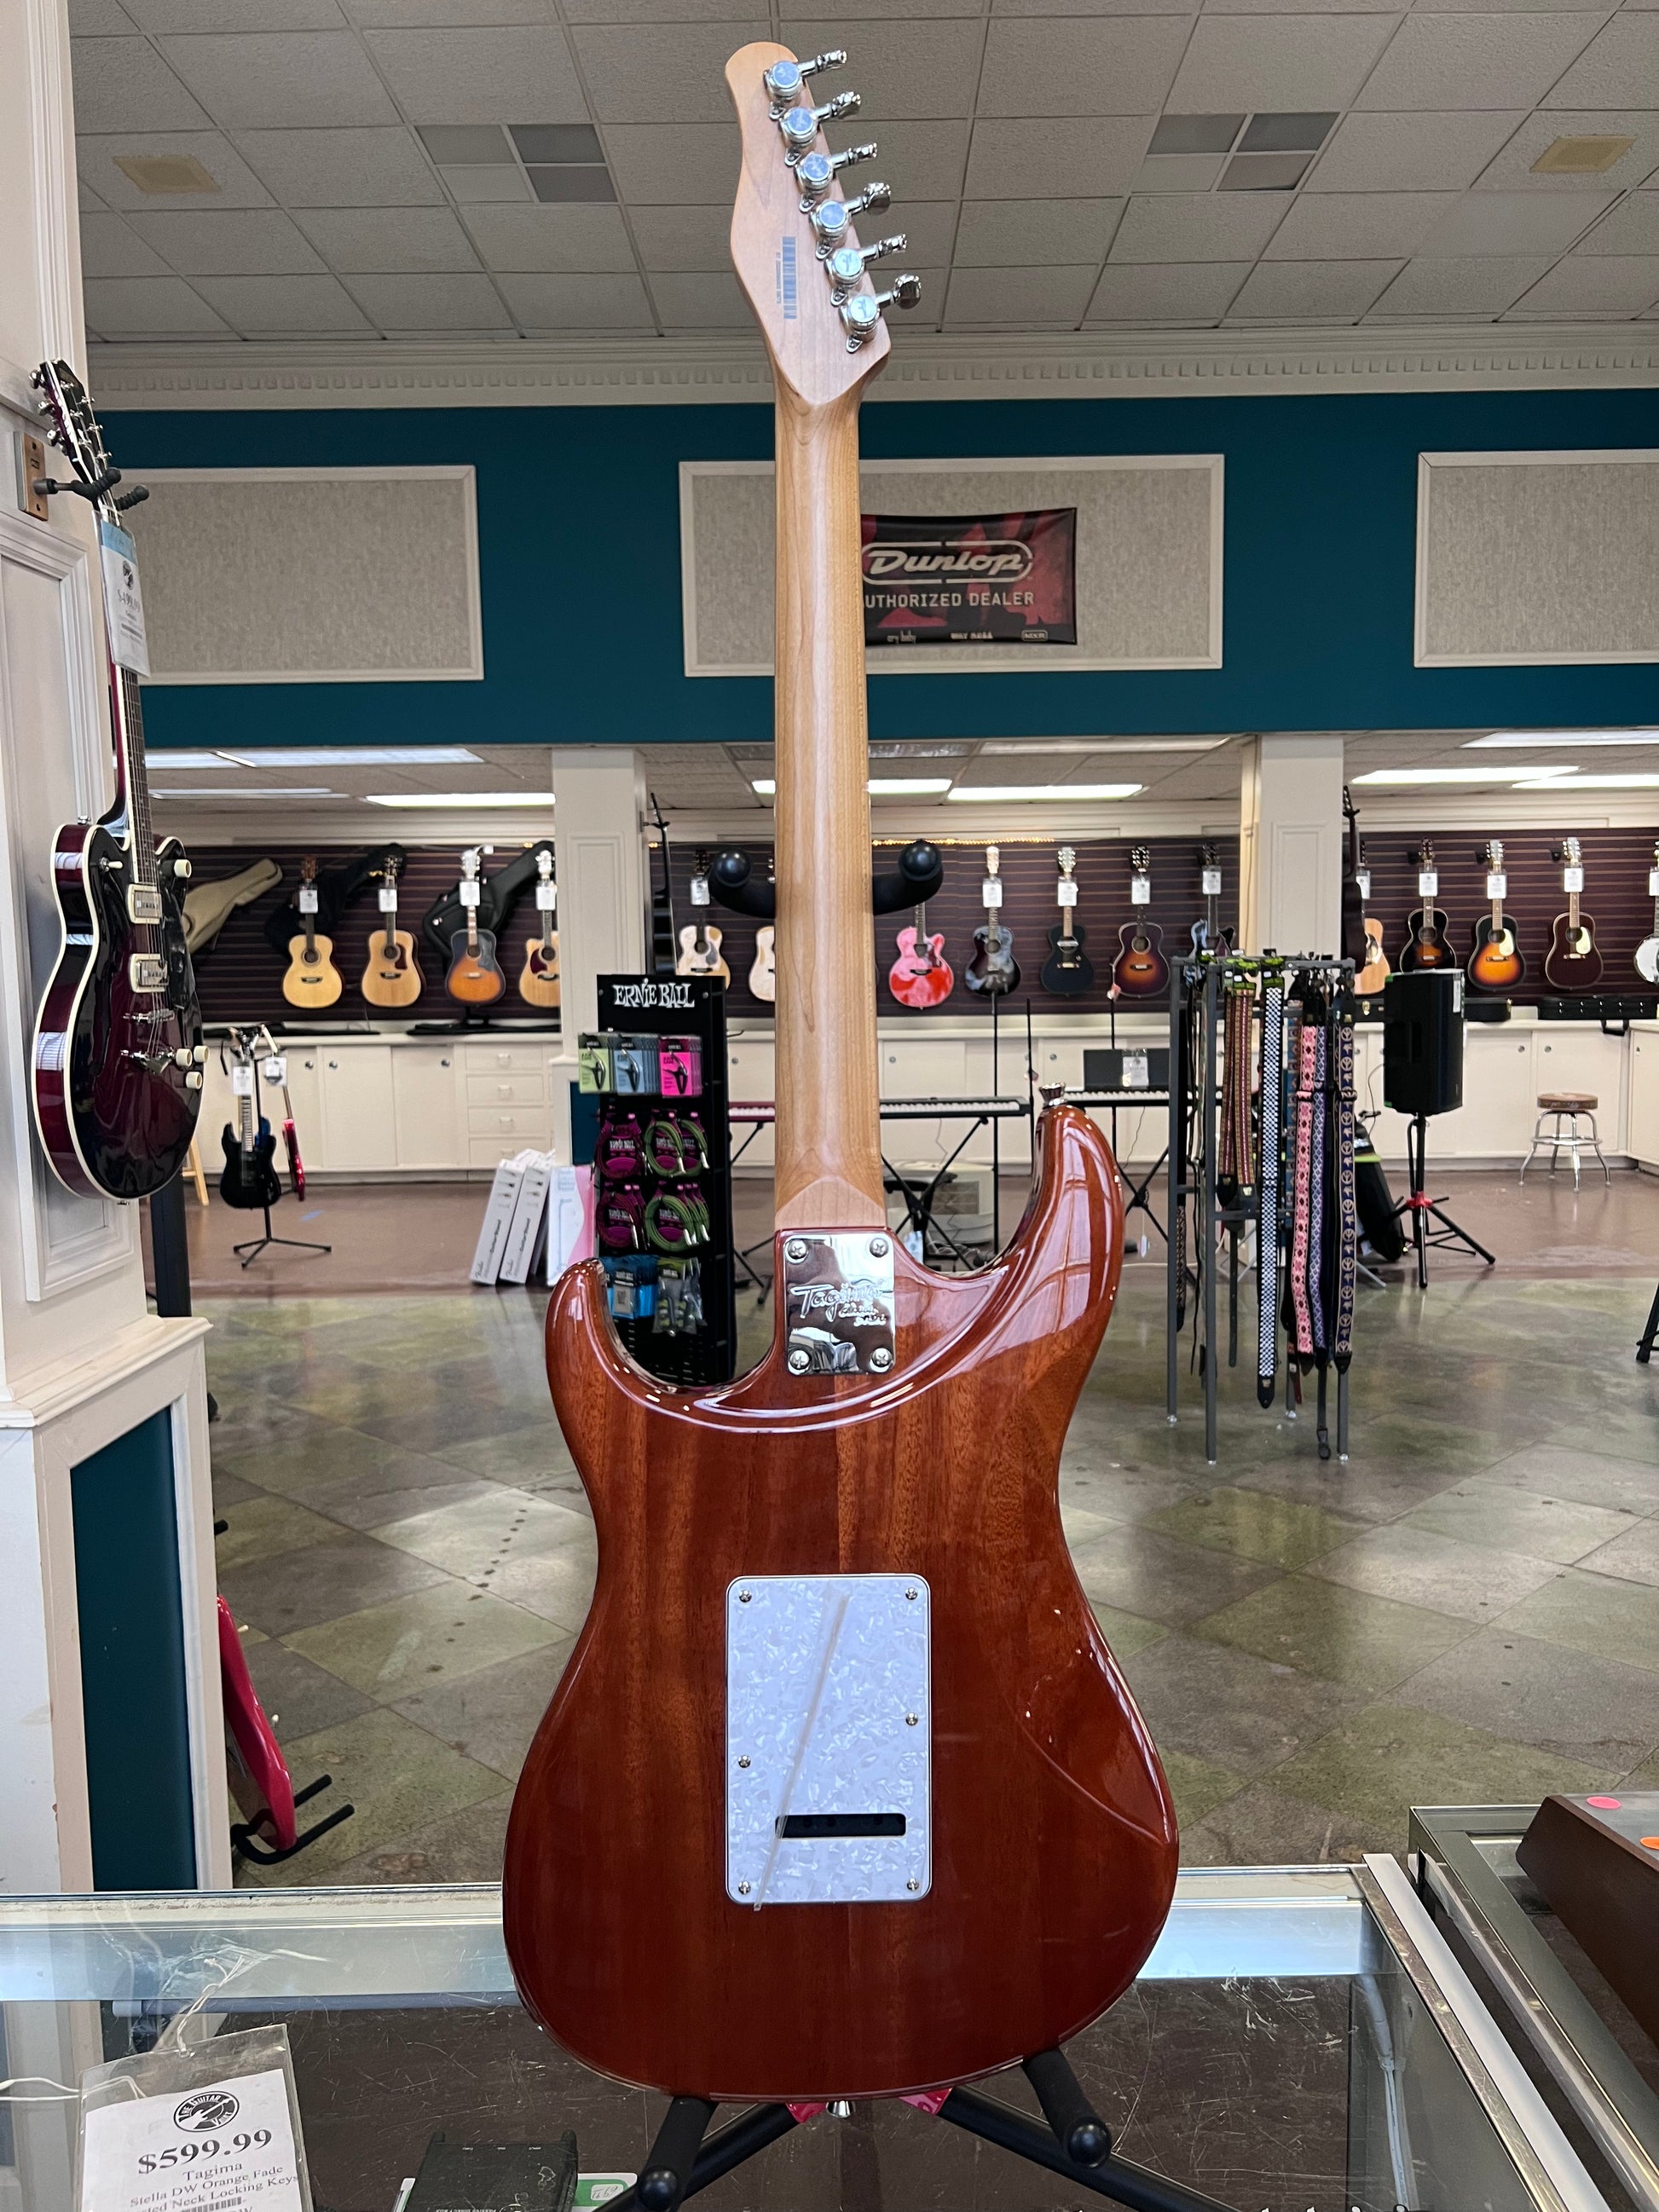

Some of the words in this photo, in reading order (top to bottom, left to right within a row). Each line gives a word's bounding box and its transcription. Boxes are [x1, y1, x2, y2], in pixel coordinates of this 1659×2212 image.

[868, 550, 1023, 575] Dunlop
[864, 592, 962, 609] UTHORIZED
[969, 592, 1035, 607] DEALER
[612, 978, 657, 1008] ERNIE
[658, 982, 695, 1008] BALL
[189, 2094, 222, 2106] GUITAR
[138, 2129, 272, 2174] $599.99
[182, 2163, 243, 2181] Tagima
[130, 2192, 167, 2208] Stella
[172, 2183, 198, 2197] DW
[202, 2174, 249, 2191] Orange
[253, 2166, 284, 2180] Fade
[172, 2194, 205, 2209] Neck
[211, 2183, 263, 2200] Locking
[268, 2174, 298, 2189] Keys
